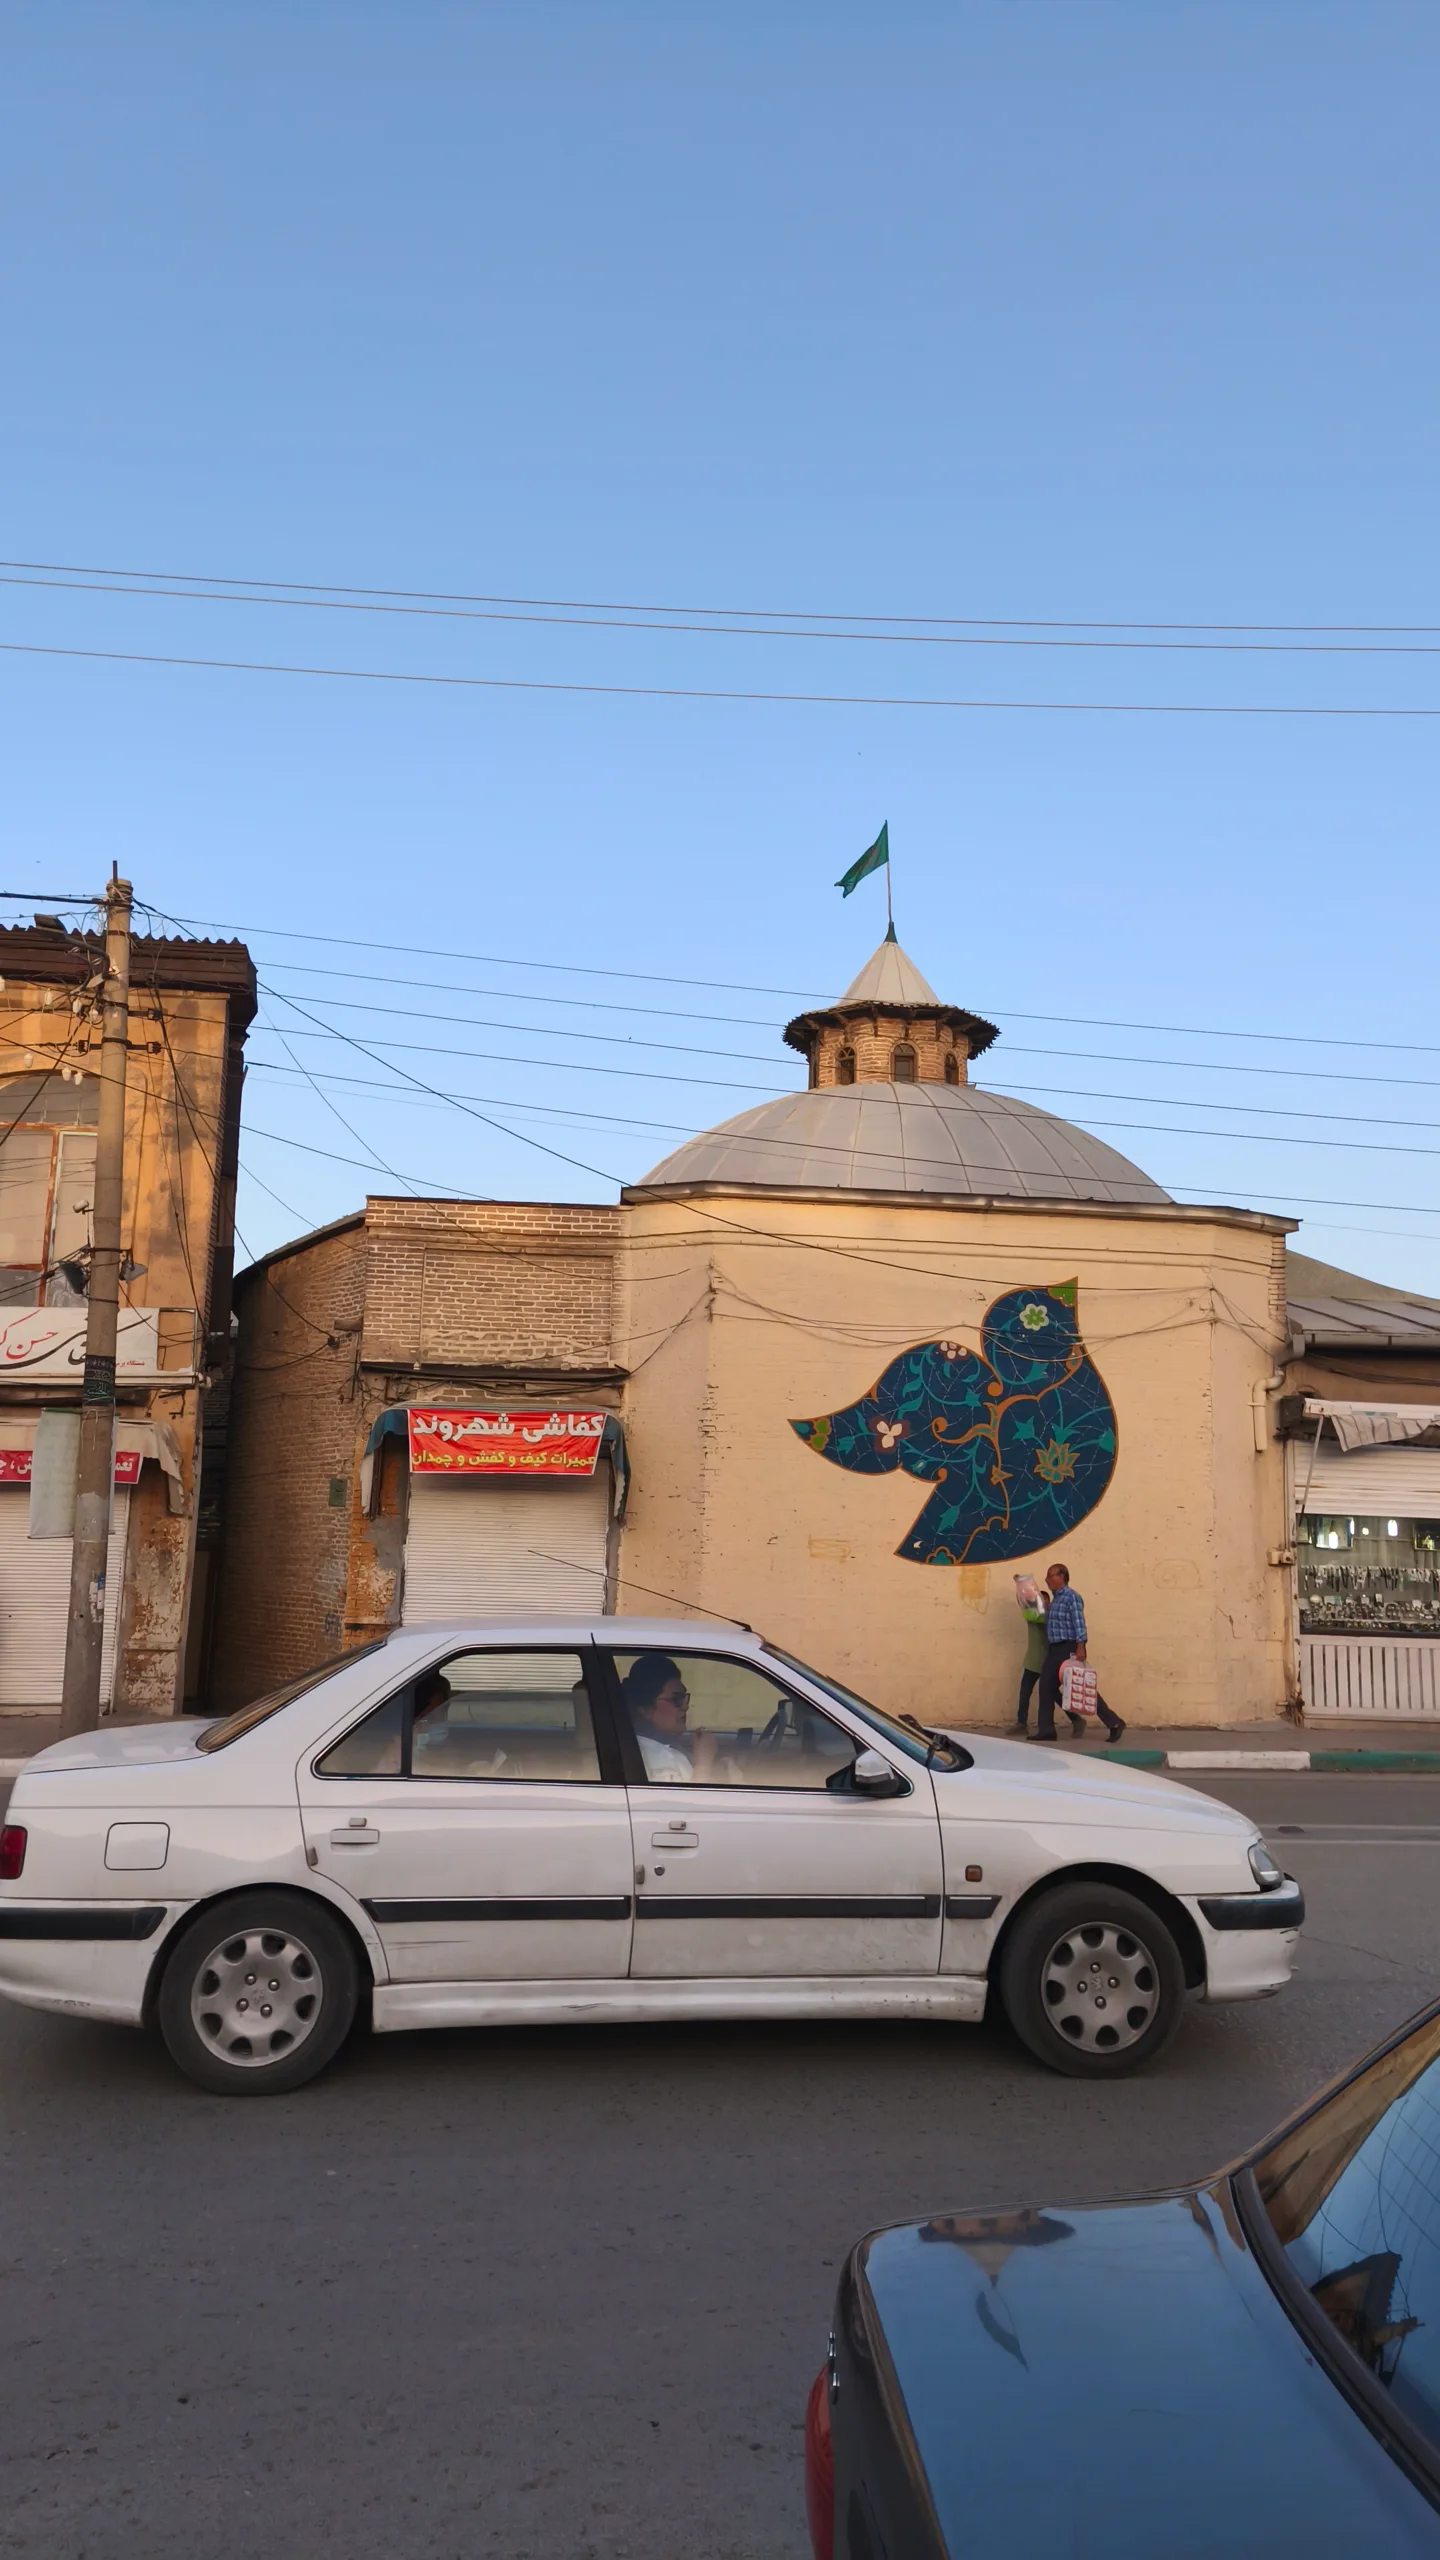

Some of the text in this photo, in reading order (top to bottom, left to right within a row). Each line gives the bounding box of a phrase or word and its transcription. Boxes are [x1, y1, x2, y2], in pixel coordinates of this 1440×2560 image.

[413, 1412, 604, 1443] کفاشی شهروند
[412, 1449, 597, 1468] عمیرات کیف و کفش و چمدان
